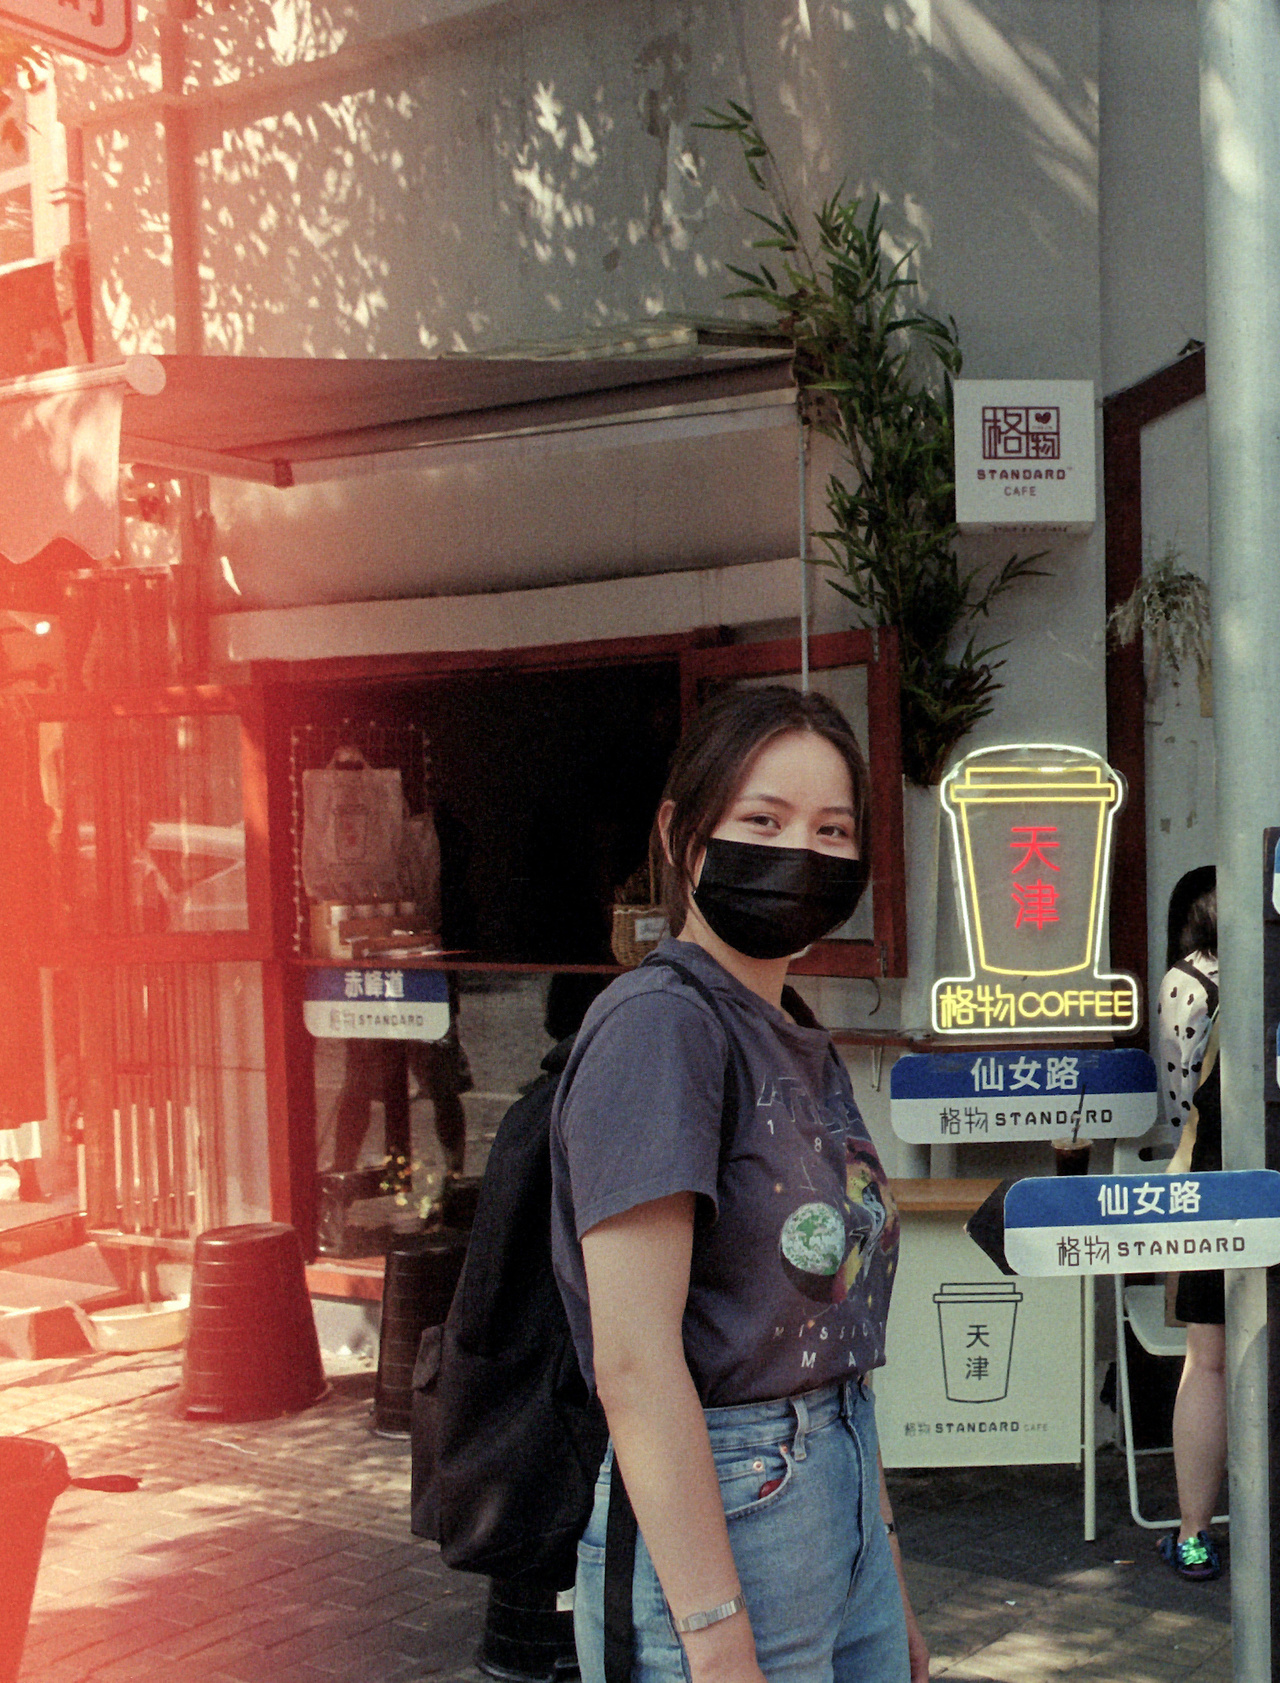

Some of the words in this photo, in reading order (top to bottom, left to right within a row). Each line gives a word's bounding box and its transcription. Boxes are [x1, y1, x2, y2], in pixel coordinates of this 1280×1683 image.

[982, 406, 1060, 459] 格物
[977, 469, 1066, 480] STANDARD
[1004, 486, 1036, 496] CAFE
[1010, 826, 1060, 931] 天津
[358, 1014, 424, 1027] STANDARD
[940, 984, 1016, 1028] 格物
[1018, 990, 1132, 1018] COFFEE
[970, 1056, 1080, 1092] 仙女路
[939, 1107, 988, 1135] 格物
[1097, 1180, 1202, 1217] 仙女路
[1056, 1235, 1110, 1266] 格物
[1117, 1236, 1246, 1257] STANDARD
[966, 1324, 990, 1381] 天津
[935, 1421, 1020, 1434] STANDARD
[1023, 1424, 1048, 1432] CAFE
